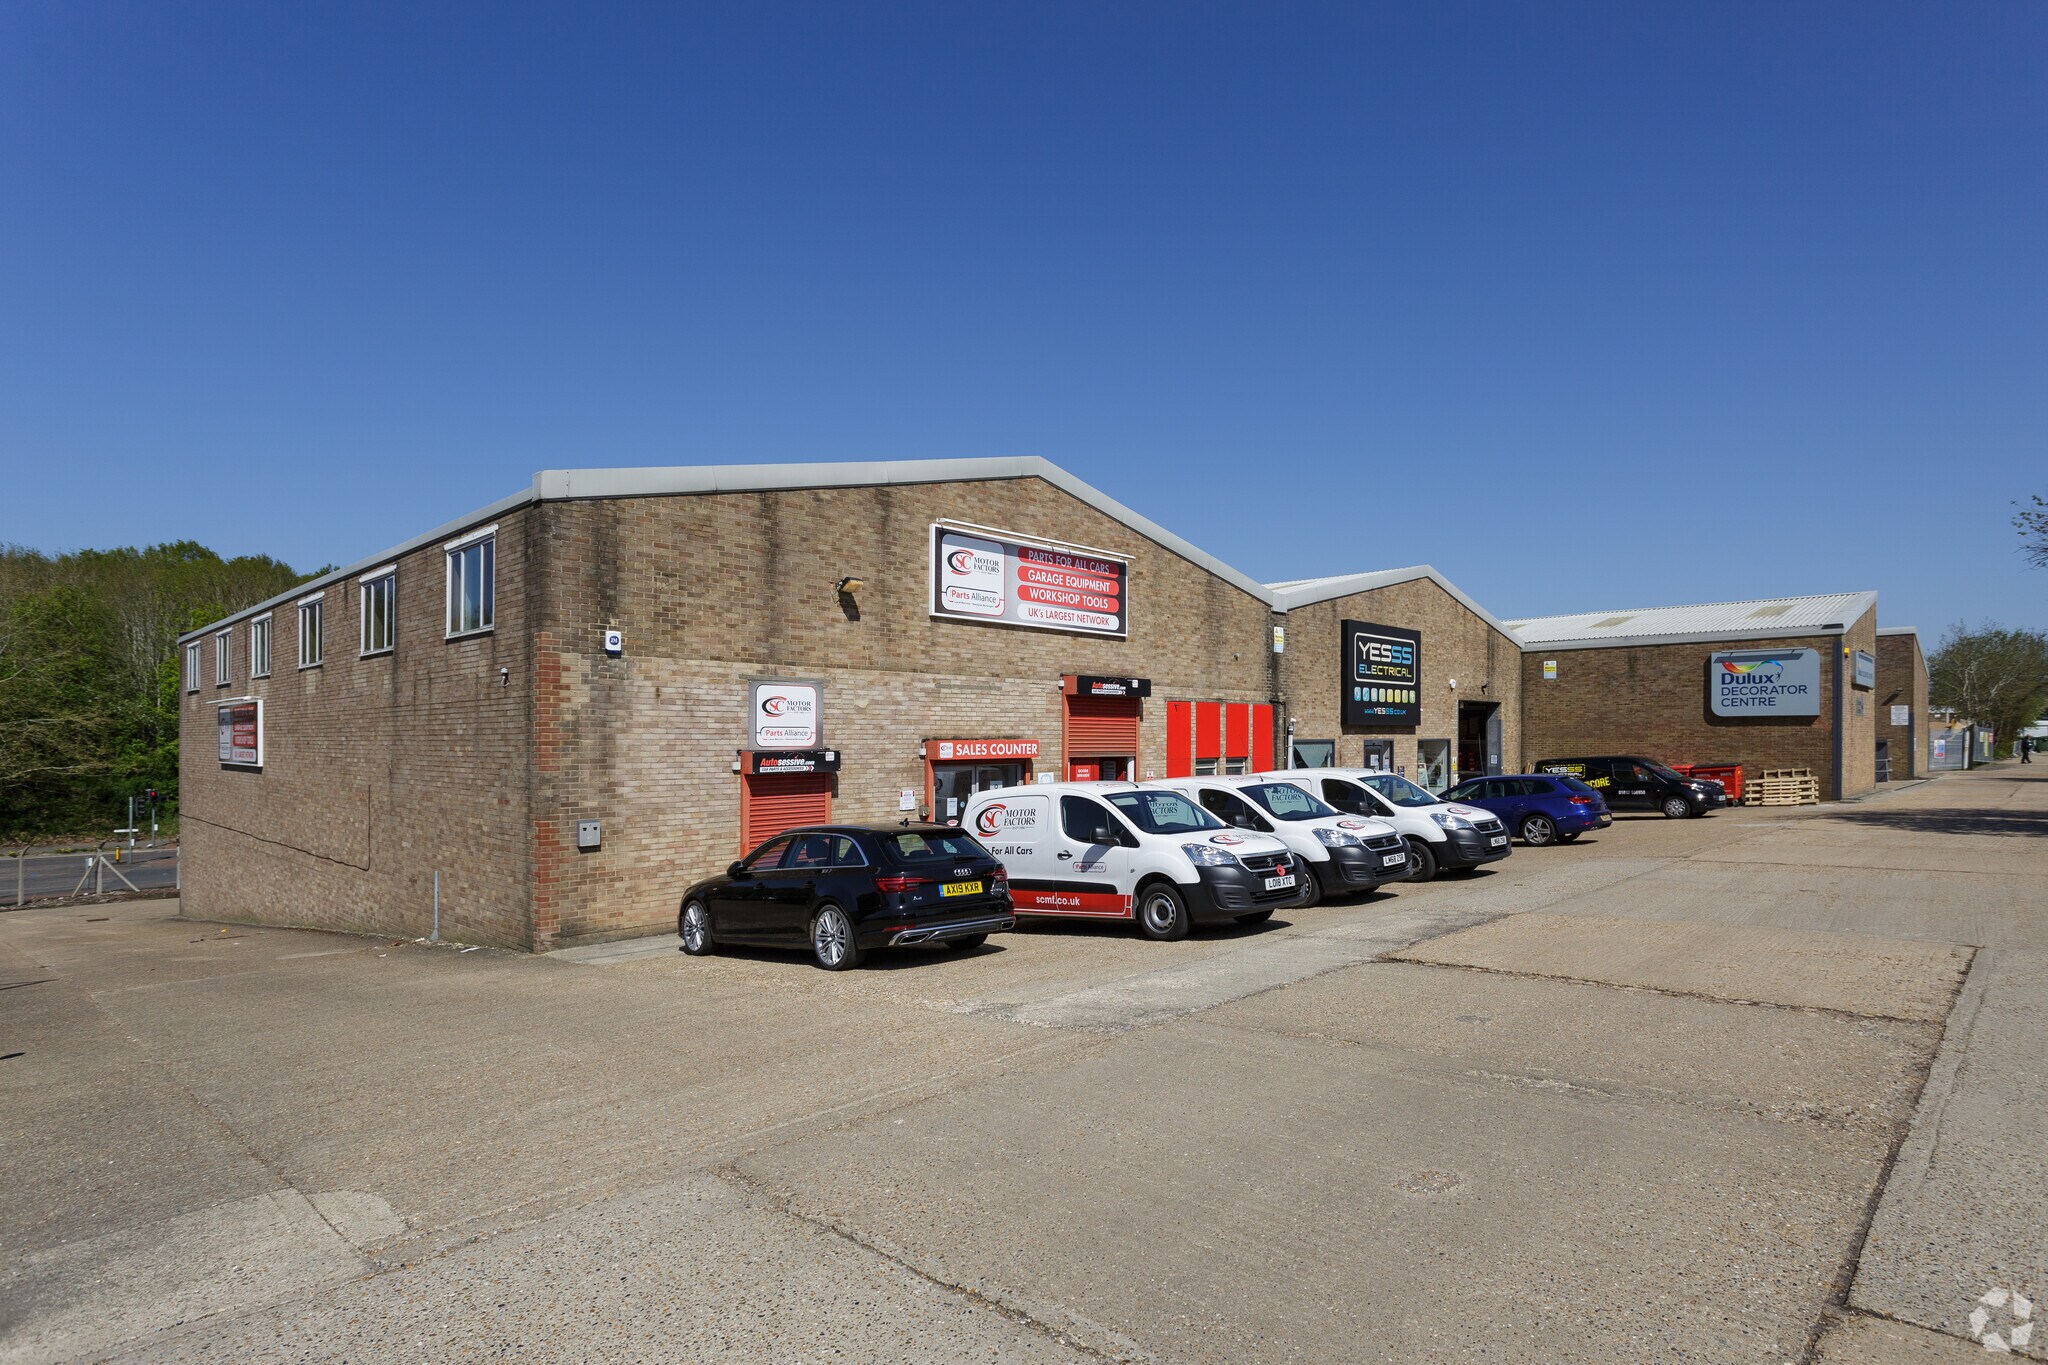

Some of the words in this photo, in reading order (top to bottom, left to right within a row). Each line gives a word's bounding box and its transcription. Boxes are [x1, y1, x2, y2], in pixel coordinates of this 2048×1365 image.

[955, 554, 972, 570] SC
[974, 556, 1000, 566] MOTOR
[1028, 550, 1053, 564] PARTS
[1056, 556, 1072, 568] FOR
[1074, 559, 1088, 571] ALL
[1090, 562, 1110, 574] CARS
[974, 564, 1000, 573] FACTORS
[1028, 570, 1064, 585] GARAGE
[1066, 576, 1110, 592] EQUIPMENT
[952, 590, 970, 600] Parts
[971, 592, 996, 603] Alliance
[1030, 588, 1080, 604] WORKSHOP
[1082, 596, 1108, 608] TOOLS
[1028, 608, 1044, 618] UK's
[1046, 610, 1074, 622] LARGEST
[1076, 614, 1110, 626] NETWORK
[1359, 641, 1412, 664] YESSS
[1359, 664, 1412, 678] ELECTRICAL
[1721, 673, 1774, 685] Dulux
[1722, 685, 1808, 696] DECORATOR
[769, 700, 784, 712] SC
[1722, 696, 1776, 707] CENTRE
[956, 744, 988, 756] SALES
[990, 744, 1038, 755] COUNTER
[760, 758, 815, 766] Autosessive.com
[1005, 808, 1036, 817] MOTOR
[984, 810, 1002, 828] SC
[1004, 817, 1036, 826] FACTORS
[992, 846, 1002, 855] For
[1004, 846, 1014, 855] All
[1016, 846, 1033, 855] Cars
[946, 884, 963, 894] AX19
[965, 882, 980, 892] KXR
[1036, 896, 1080, 906] scmf.co.uk
